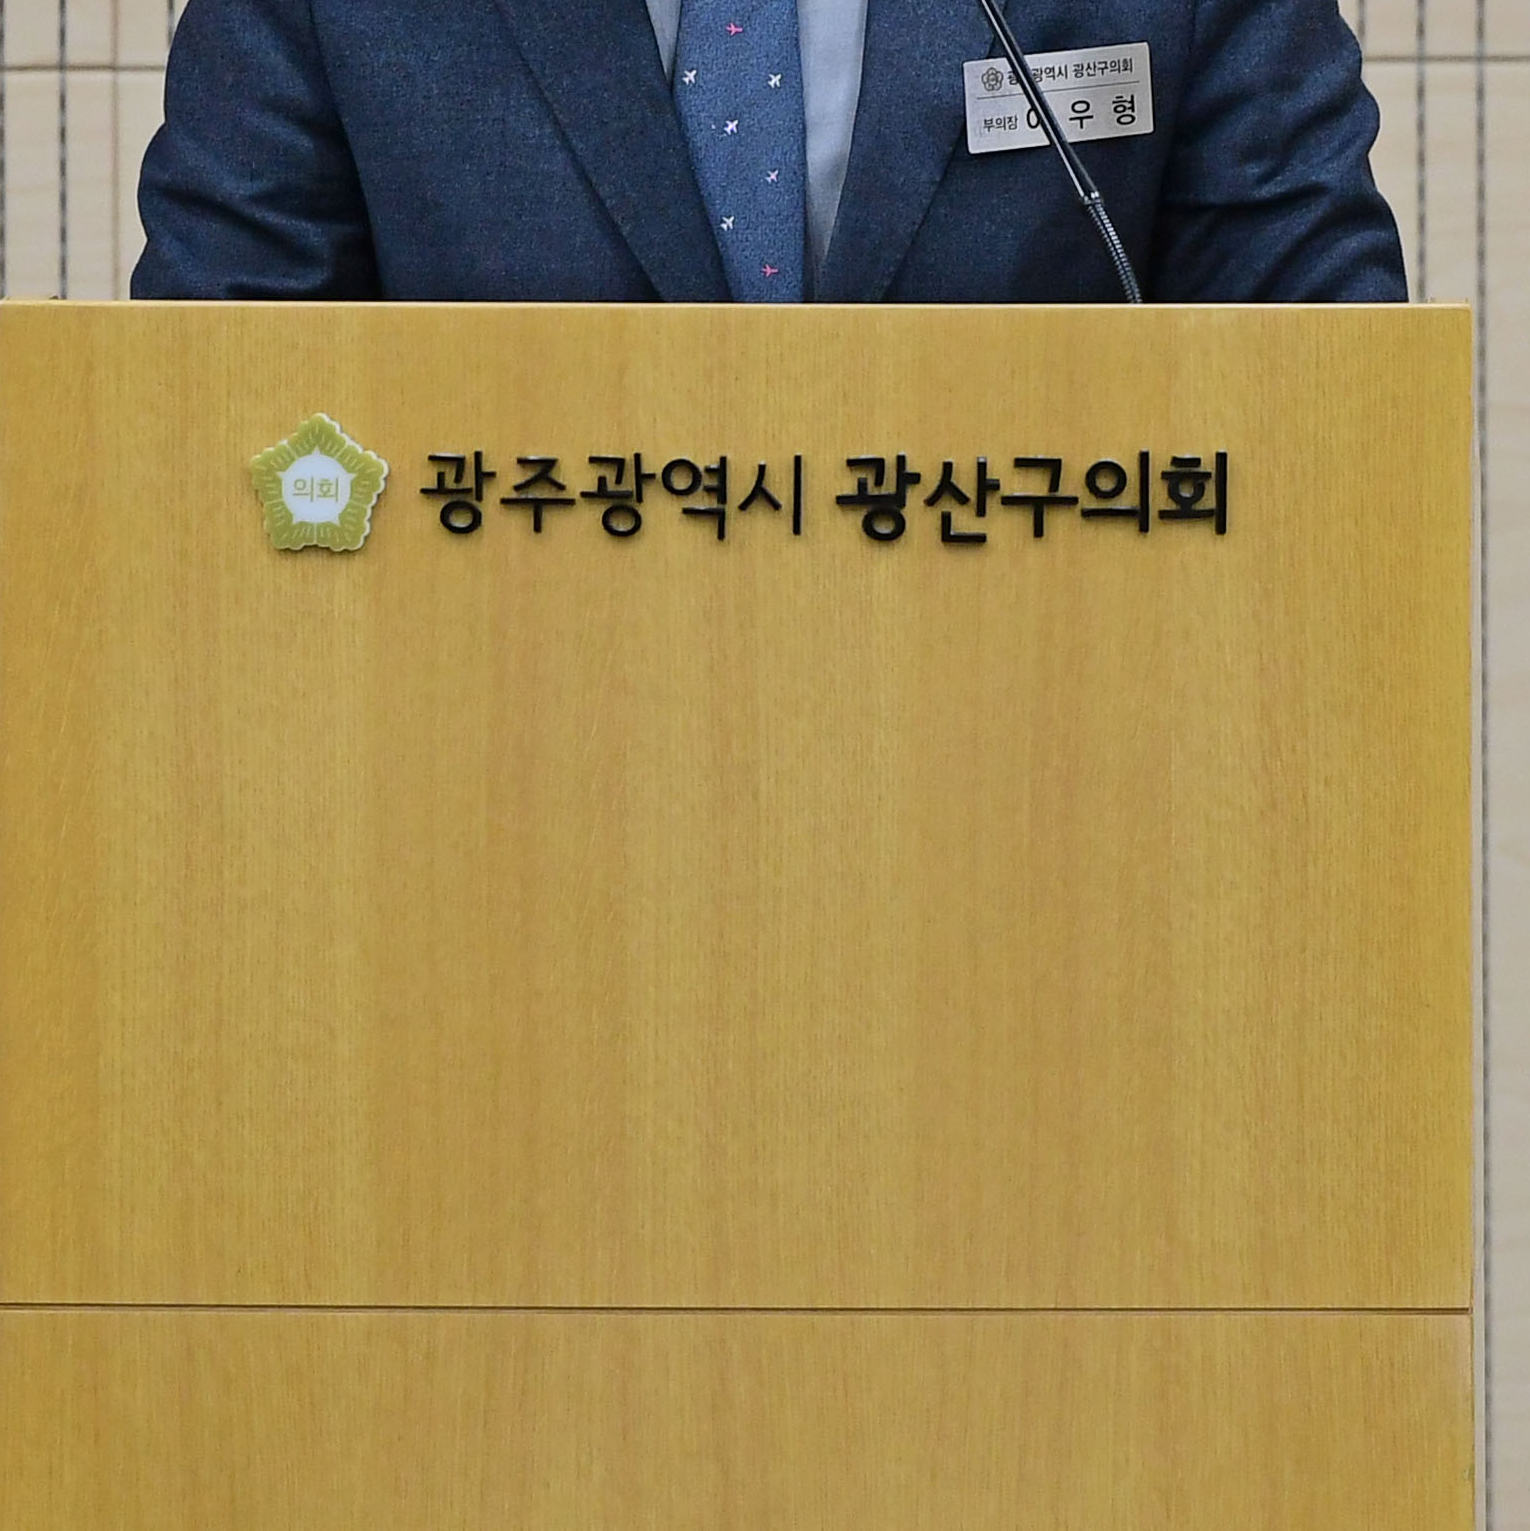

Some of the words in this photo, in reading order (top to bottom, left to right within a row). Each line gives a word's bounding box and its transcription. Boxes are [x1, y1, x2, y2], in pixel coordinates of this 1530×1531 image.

[1007, 64, 1069, 86] 광광역시
[1072, 58, 1134, 79] 광산구의회
[983, 115, 1019, 132] 부의장
[292, 476, 340, 503] 의회
[419, 449, 803, 541] 광주광역시
[835, 448, 1229, 543] 광산구의회
